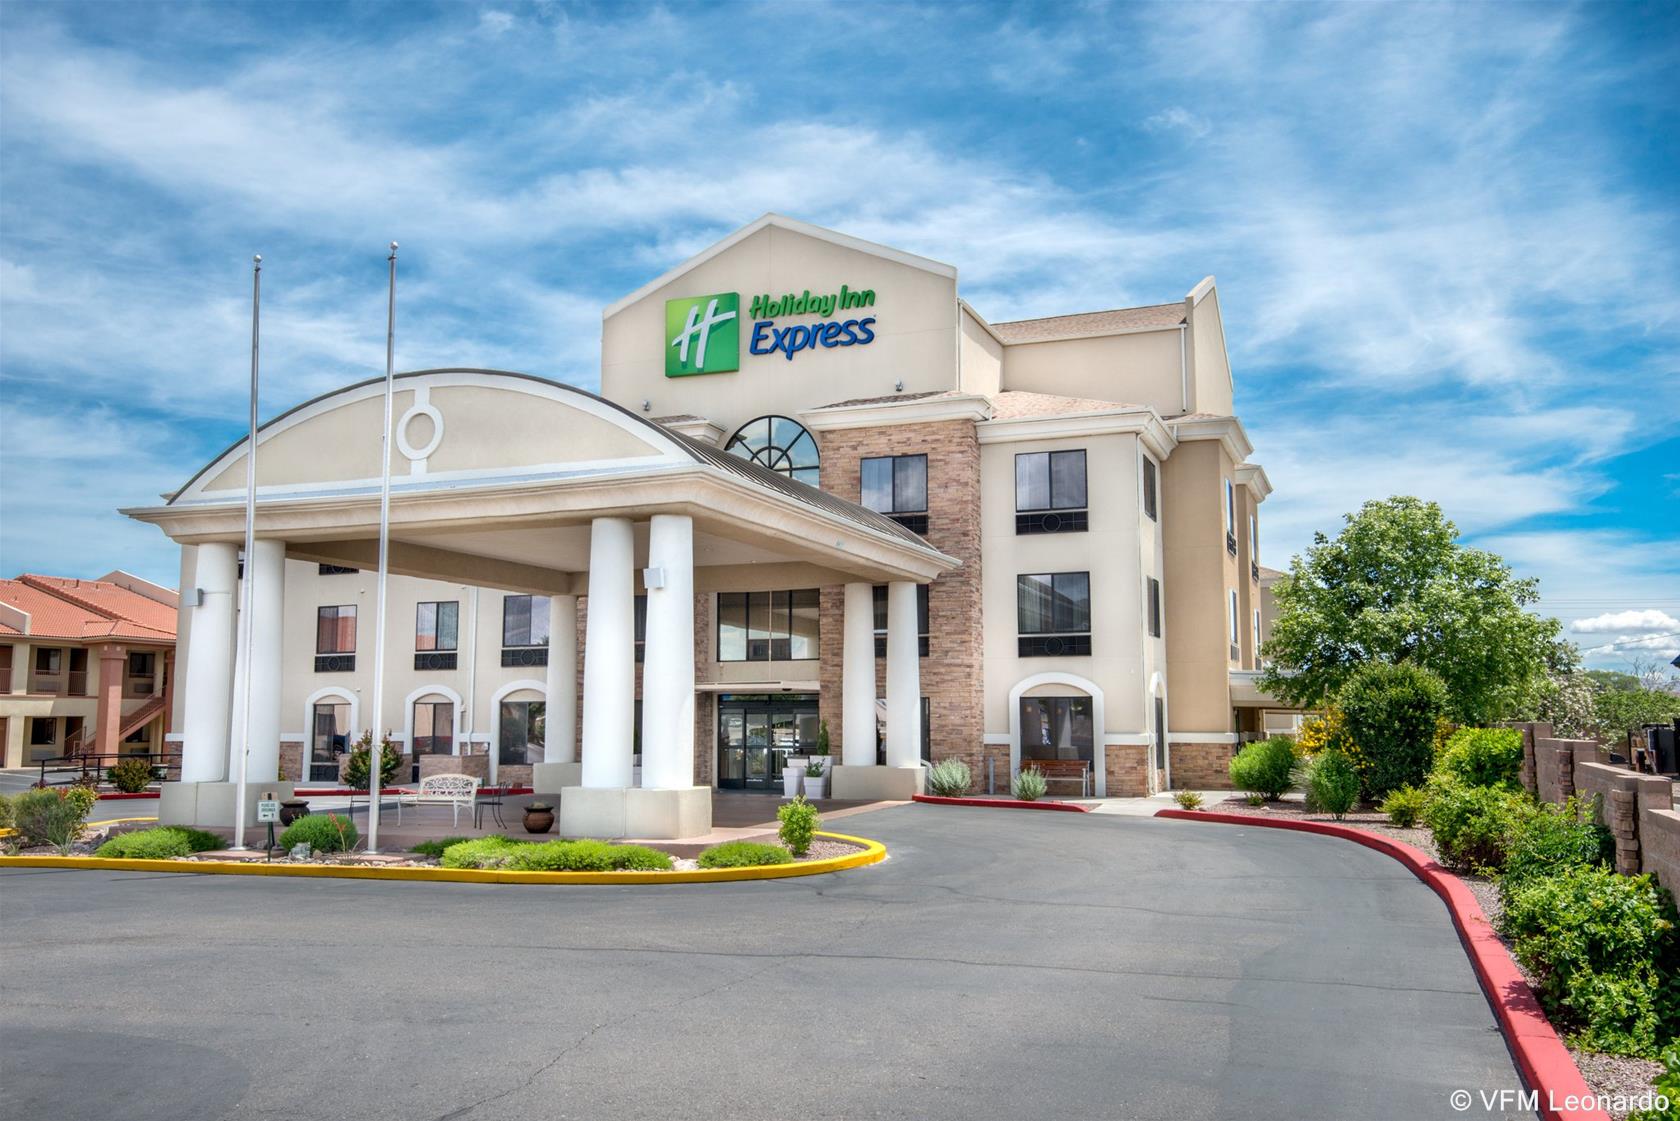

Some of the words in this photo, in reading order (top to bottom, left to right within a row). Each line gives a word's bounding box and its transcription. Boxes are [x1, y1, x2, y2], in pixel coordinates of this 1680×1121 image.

[749, 290, 837, 320] Holiday
[838, 285, 876, 310] Inn
[749, 317, 876, 361] Express
